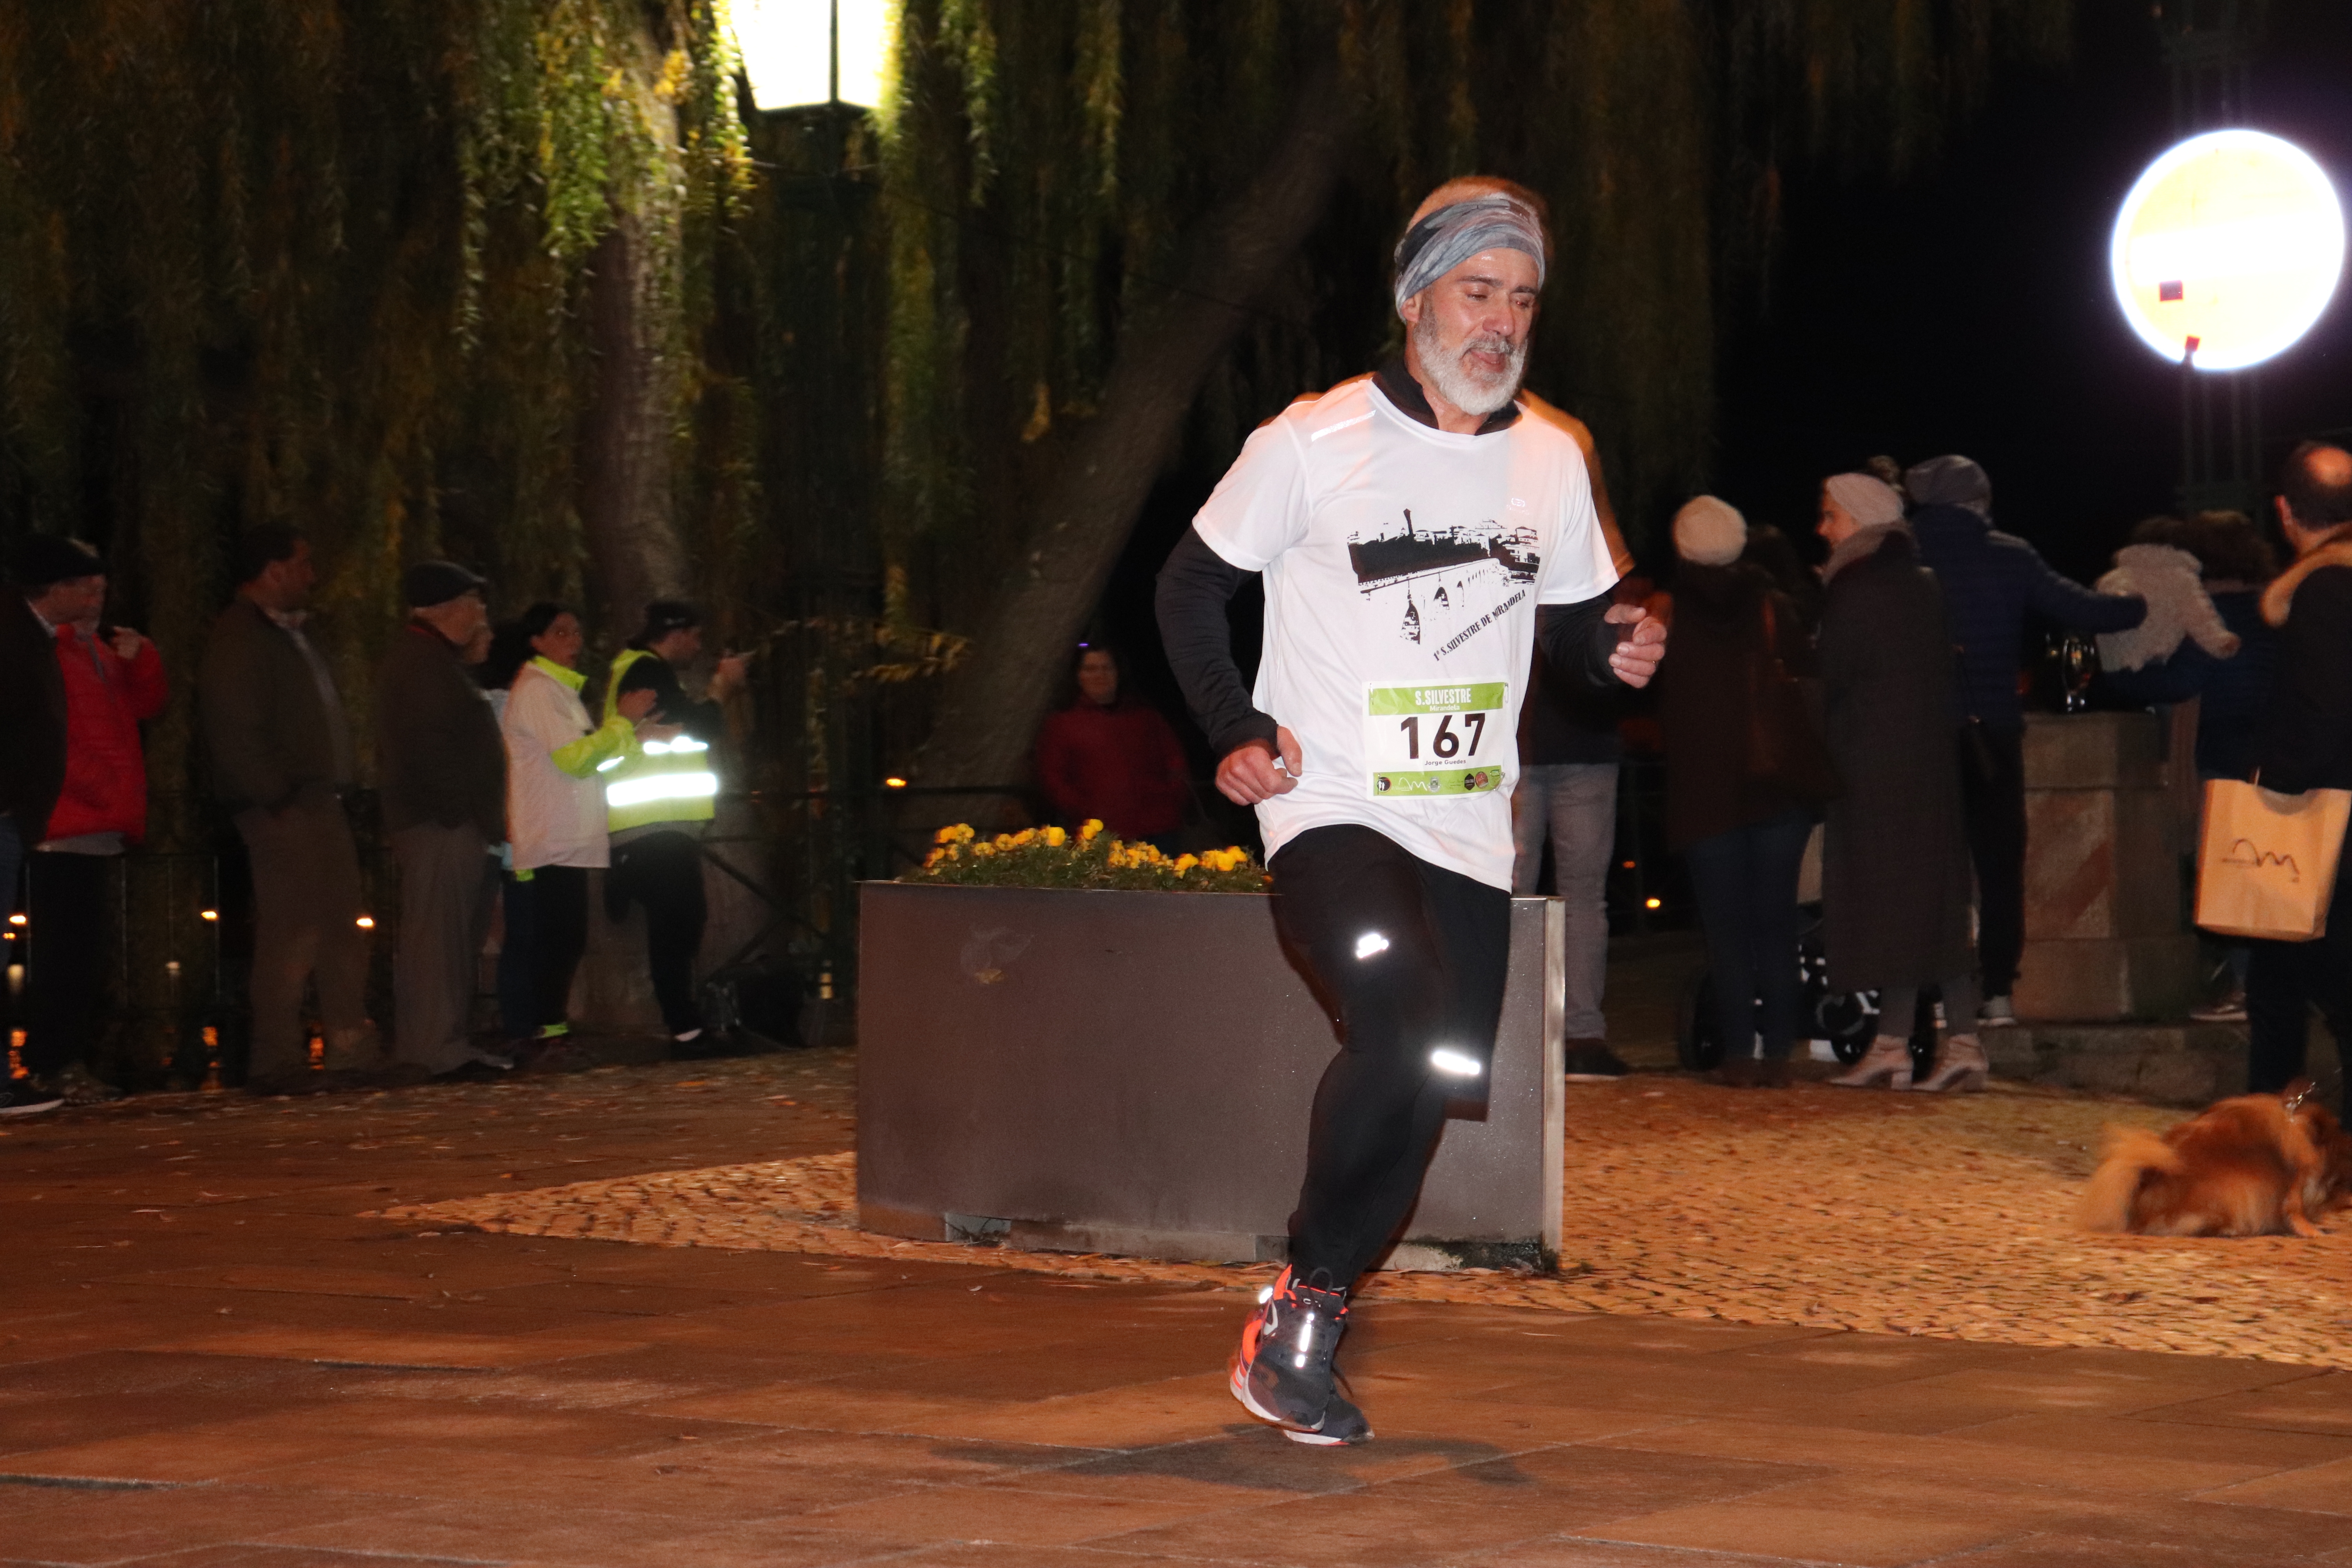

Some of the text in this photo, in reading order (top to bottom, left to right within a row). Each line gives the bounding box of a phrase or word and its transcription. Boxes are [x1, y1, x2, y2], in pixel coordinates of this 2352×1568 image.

[1441, 621, 1482, 655] S.SILVESTRE
[1481, 614, 1492, 627] DE
[1415, 688, 1471, 706] S.SILVESTRE
[1401, 713, 1486, 759] 167
